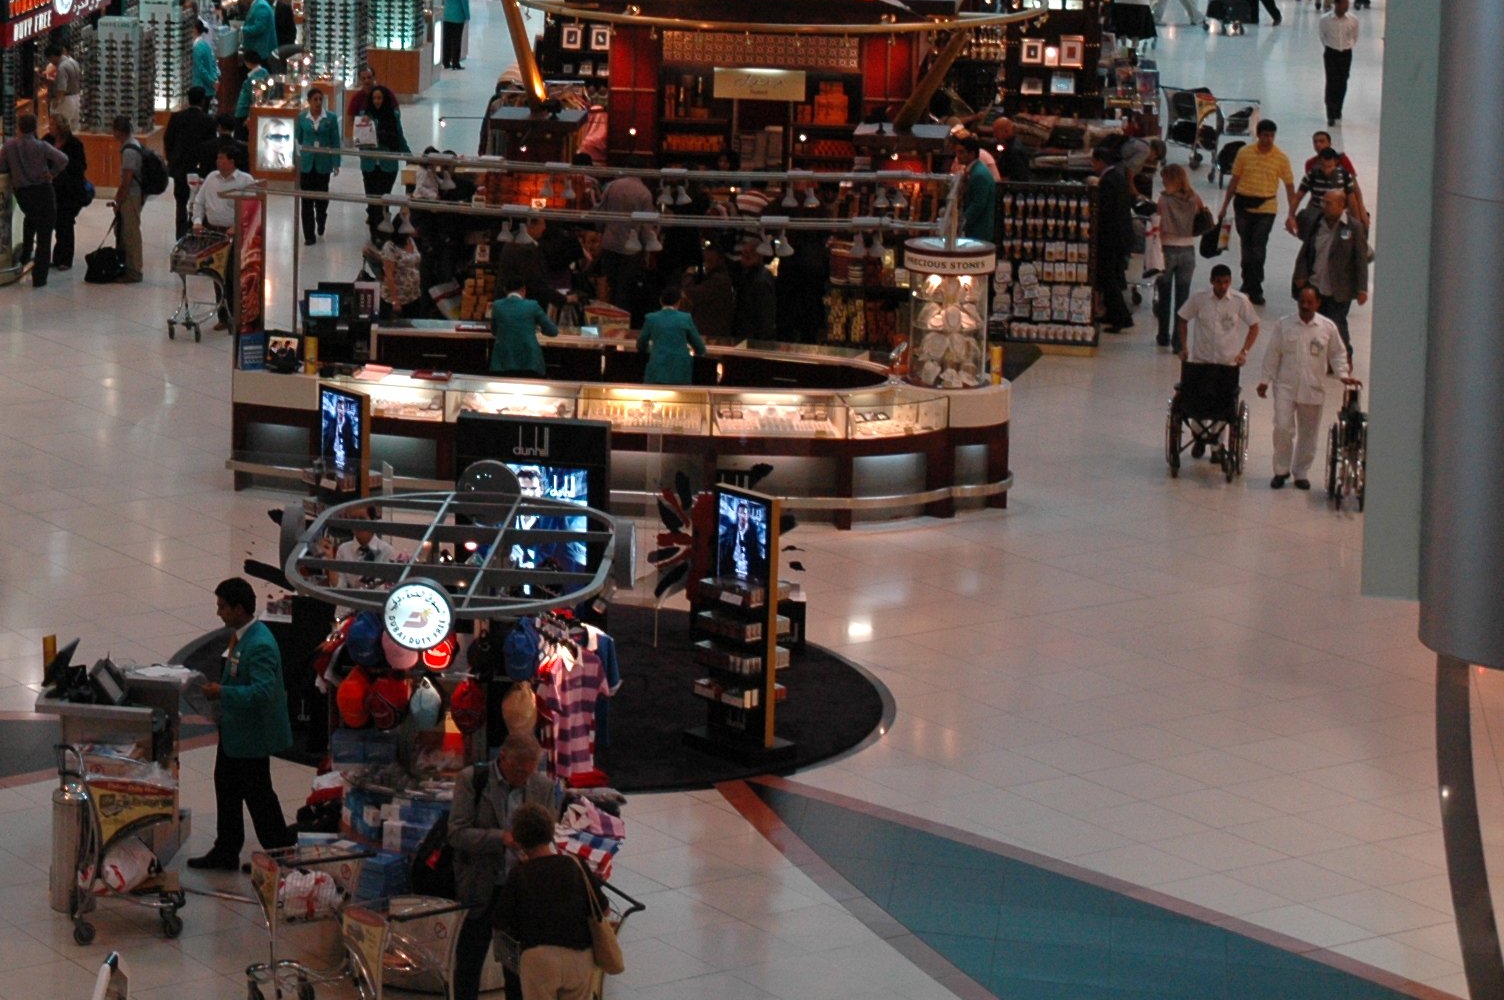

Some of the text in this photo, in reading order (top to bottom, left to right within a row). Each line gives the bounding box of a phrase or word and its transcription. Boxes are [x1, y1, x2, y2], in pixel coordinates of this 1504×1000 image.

[13, 9, 52, 42] DUTY FREE
[906, 255, 986, 270] PRECIOUS STONES
[512, 425, 549, 457] dunhill
[389, 615, 446, 645] DUBAI DUTY FREE
